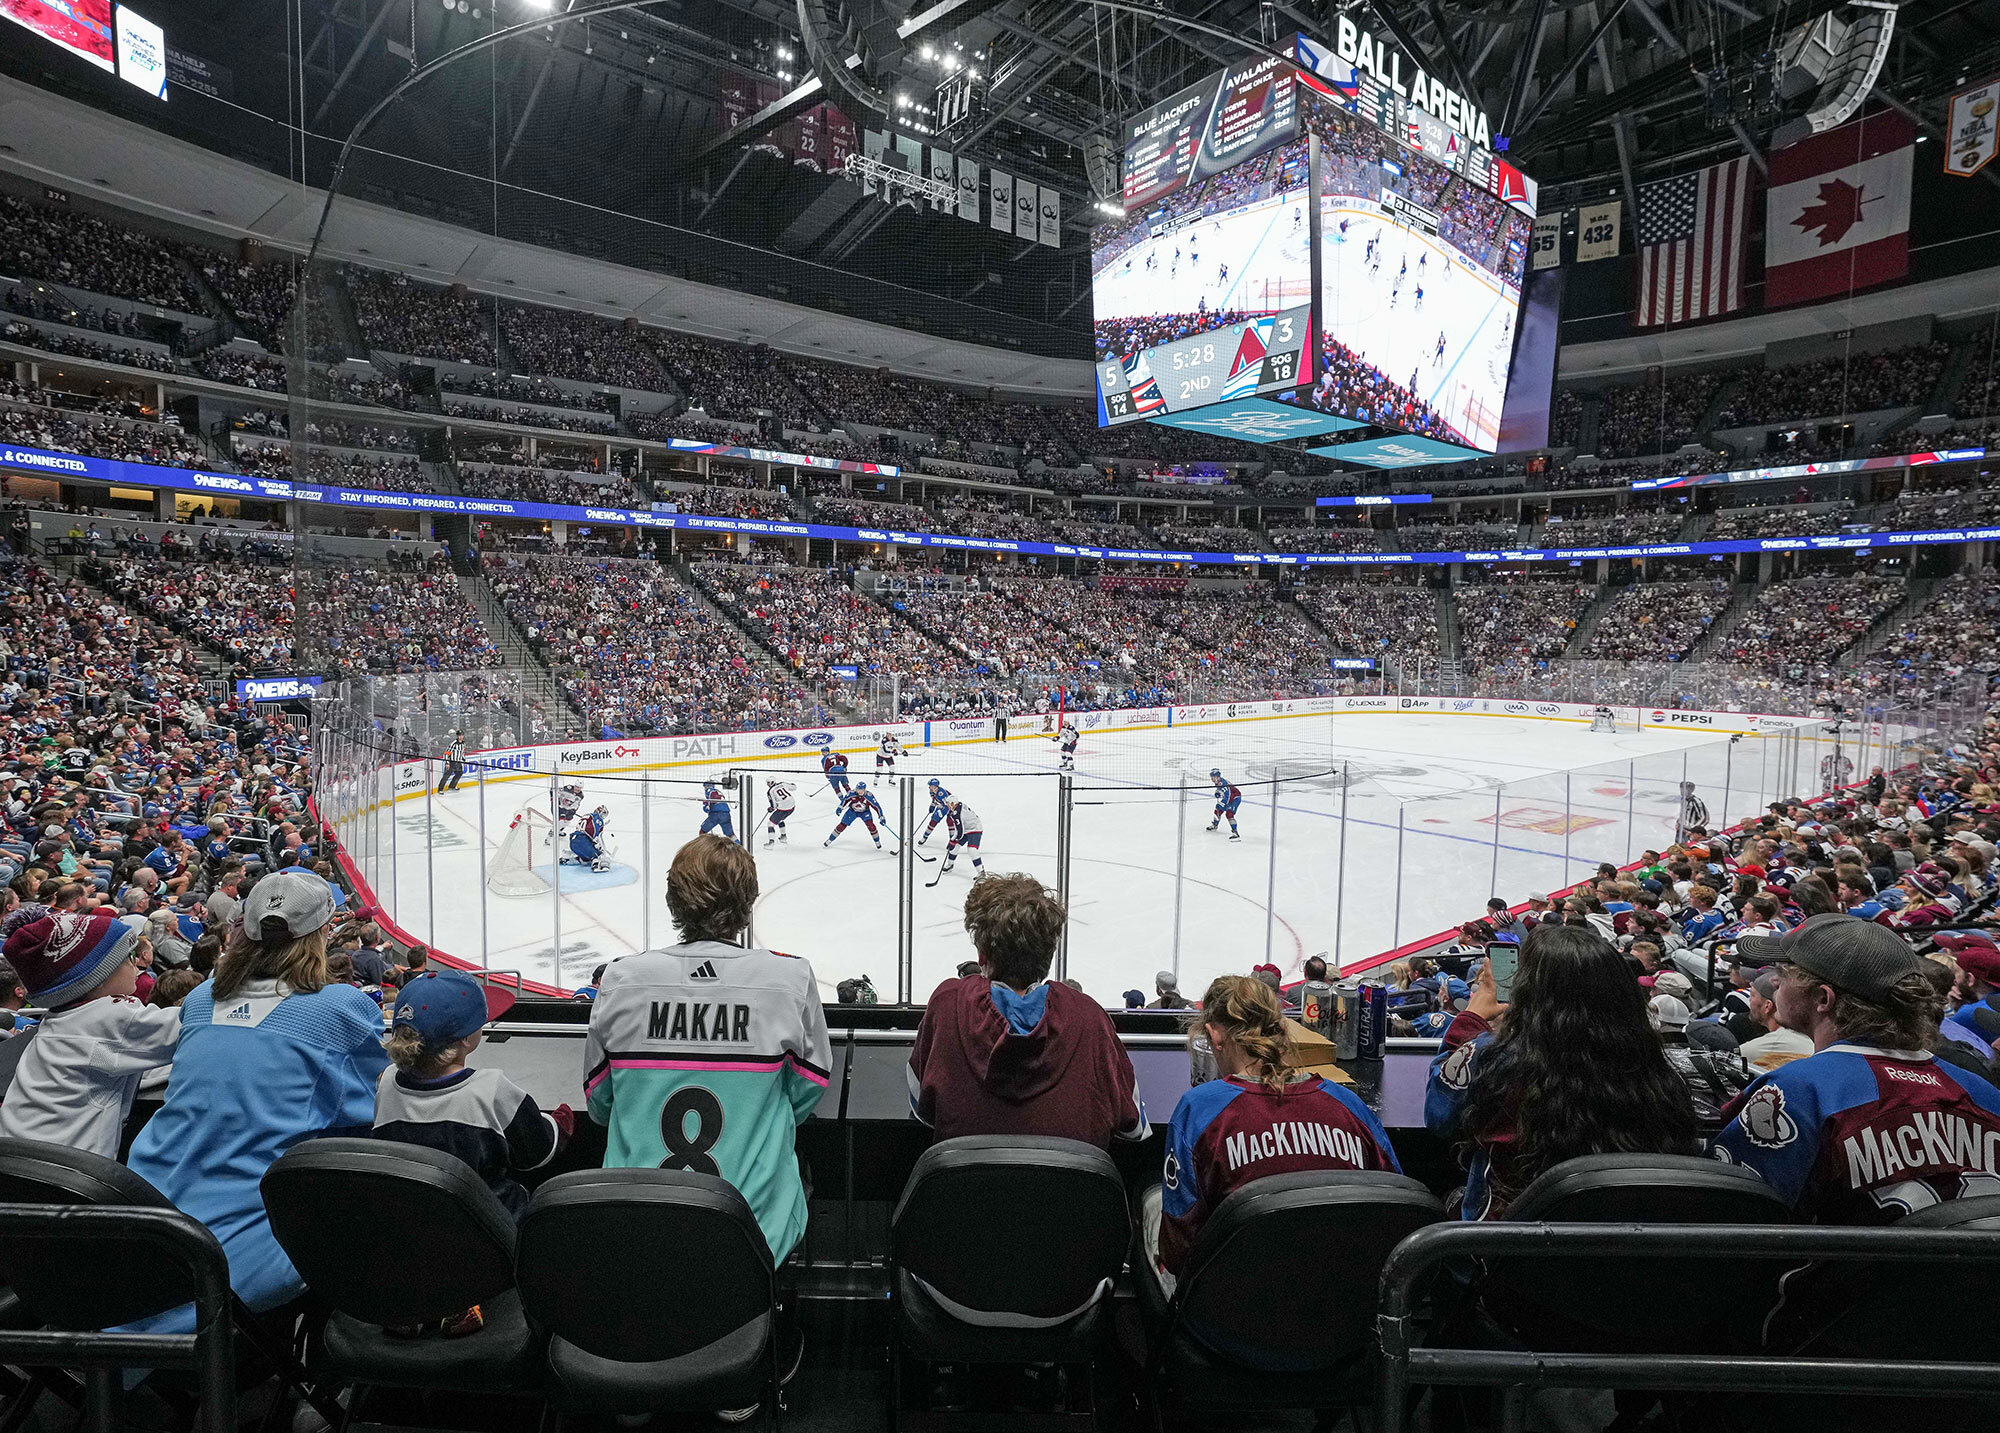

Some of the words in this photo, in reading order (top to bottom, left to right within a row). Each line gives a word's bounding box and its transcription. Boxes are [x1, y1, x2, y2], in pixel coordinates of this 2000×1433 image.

[1225, 46, 1294, 91] AVALANCE
[1238, 82, 1253, 95] TIME
[1253, 77, 1262, 88] ON
[1262, 71, 1274, 83] ICE
[1338, 14, 1406, 97] BALL
[1410, 69, 1491, 151] ARENA
[1224, 98, 1247, 114] TOEWS
[1398, 101, 1405, 116] 5
[730, 112, 738, 127] 6
[1134, 117, 1157, 138] BLUE
[1158, 95, 1200, 125] JACKETS
[1223, 111, 1262, 134] MACKINNON
[1224, 108, 1247, 125] MAKAR
[1425, 121, 1442, 141] 5:28
[1960, 119, 1987, 138] NBA
[801, 136, 815, 153] 22
[833, 145, 846, 160] 24
[1424, 138, 1441, 157] 2ND
[1460, 140, 1466, 155] 3
[1583, 223, 1614, 245] 432
[1277, 316, 1294, 343] 3
[1173, 343, 1215, 371] 5:28
[1270, 353, 1293, 367] SOG
[1105, 365, 1117, 387] 5
[1273, 364, 1292, 381] 18
[1180, 375, 1211, 400] 2ND
[1110, 392, 1127, 404] SOG
[1113, 404, 1128, 416] 14
[4, 450, 15, 462] &
[15, 452, 88, 472] CONNECTED.
[193, 474, 239, 491] 9NEWS
[340, 492, 361, 502] STAY
[363, 494, 411, 507] INFORMED,
[412, 498, 457, 509] PREPARED,
[458, 501, 465, 510] &
[466, 501, 515, 513] CONNECTED.
[586, 509, 617, 520] 9NEWS
[688, 518, 704, 526] STAY
[704, 520, 737, 529] INFORMED,
[737, 522, 769, 532] PREPARED,
[774, 525, 809, 534] CONNECTED.
[1760, 539, 1796, 549] 9NEWS
[1888, 535, 1911, 543] STAY
[1912, 533, 1966, 542] INFORMED,
[1464, 553, 1492, 561] 9NEWS
[1572, 550, 1607, 558] INFORMED,
[1607, 549, 1643, 557] PREPARED,
[1648, 546, 1691, 554] CONNECTED.
[245, 681, 299, 699] 9NEWS
[1453, 700, 1475, 711] Ball
[1085, 712, 1102, 728] Ball
[1128, 710, 1160, 723] uchealth
[1671, 713, 1713, 724] PEPSI
[1759, 718, 1794, 728] Fanatics
[949, 720, 985, 731] Quantum
[674, 736, 736, 758] PATH
[769, 735, 791, 747] Ford
[807, 733, 829, 745] Ford
[482, 753, 532, 772] LIGHT
[560, 749, 612, 765] KeyBank
[776, 787, 791, 801] 91
[1776, 877, 1786, 886] 8
[1686, 931, 1695, 942] 8
[226, 1012, 252, 1020] adidas
[646, 1000, 750, 1043] MAKAR
[1360, 1003, 1372, 1046] ULTRA
[1884, 1065, 1942, 1088] Reebok
[658, 1084, 725, 1178] 8
